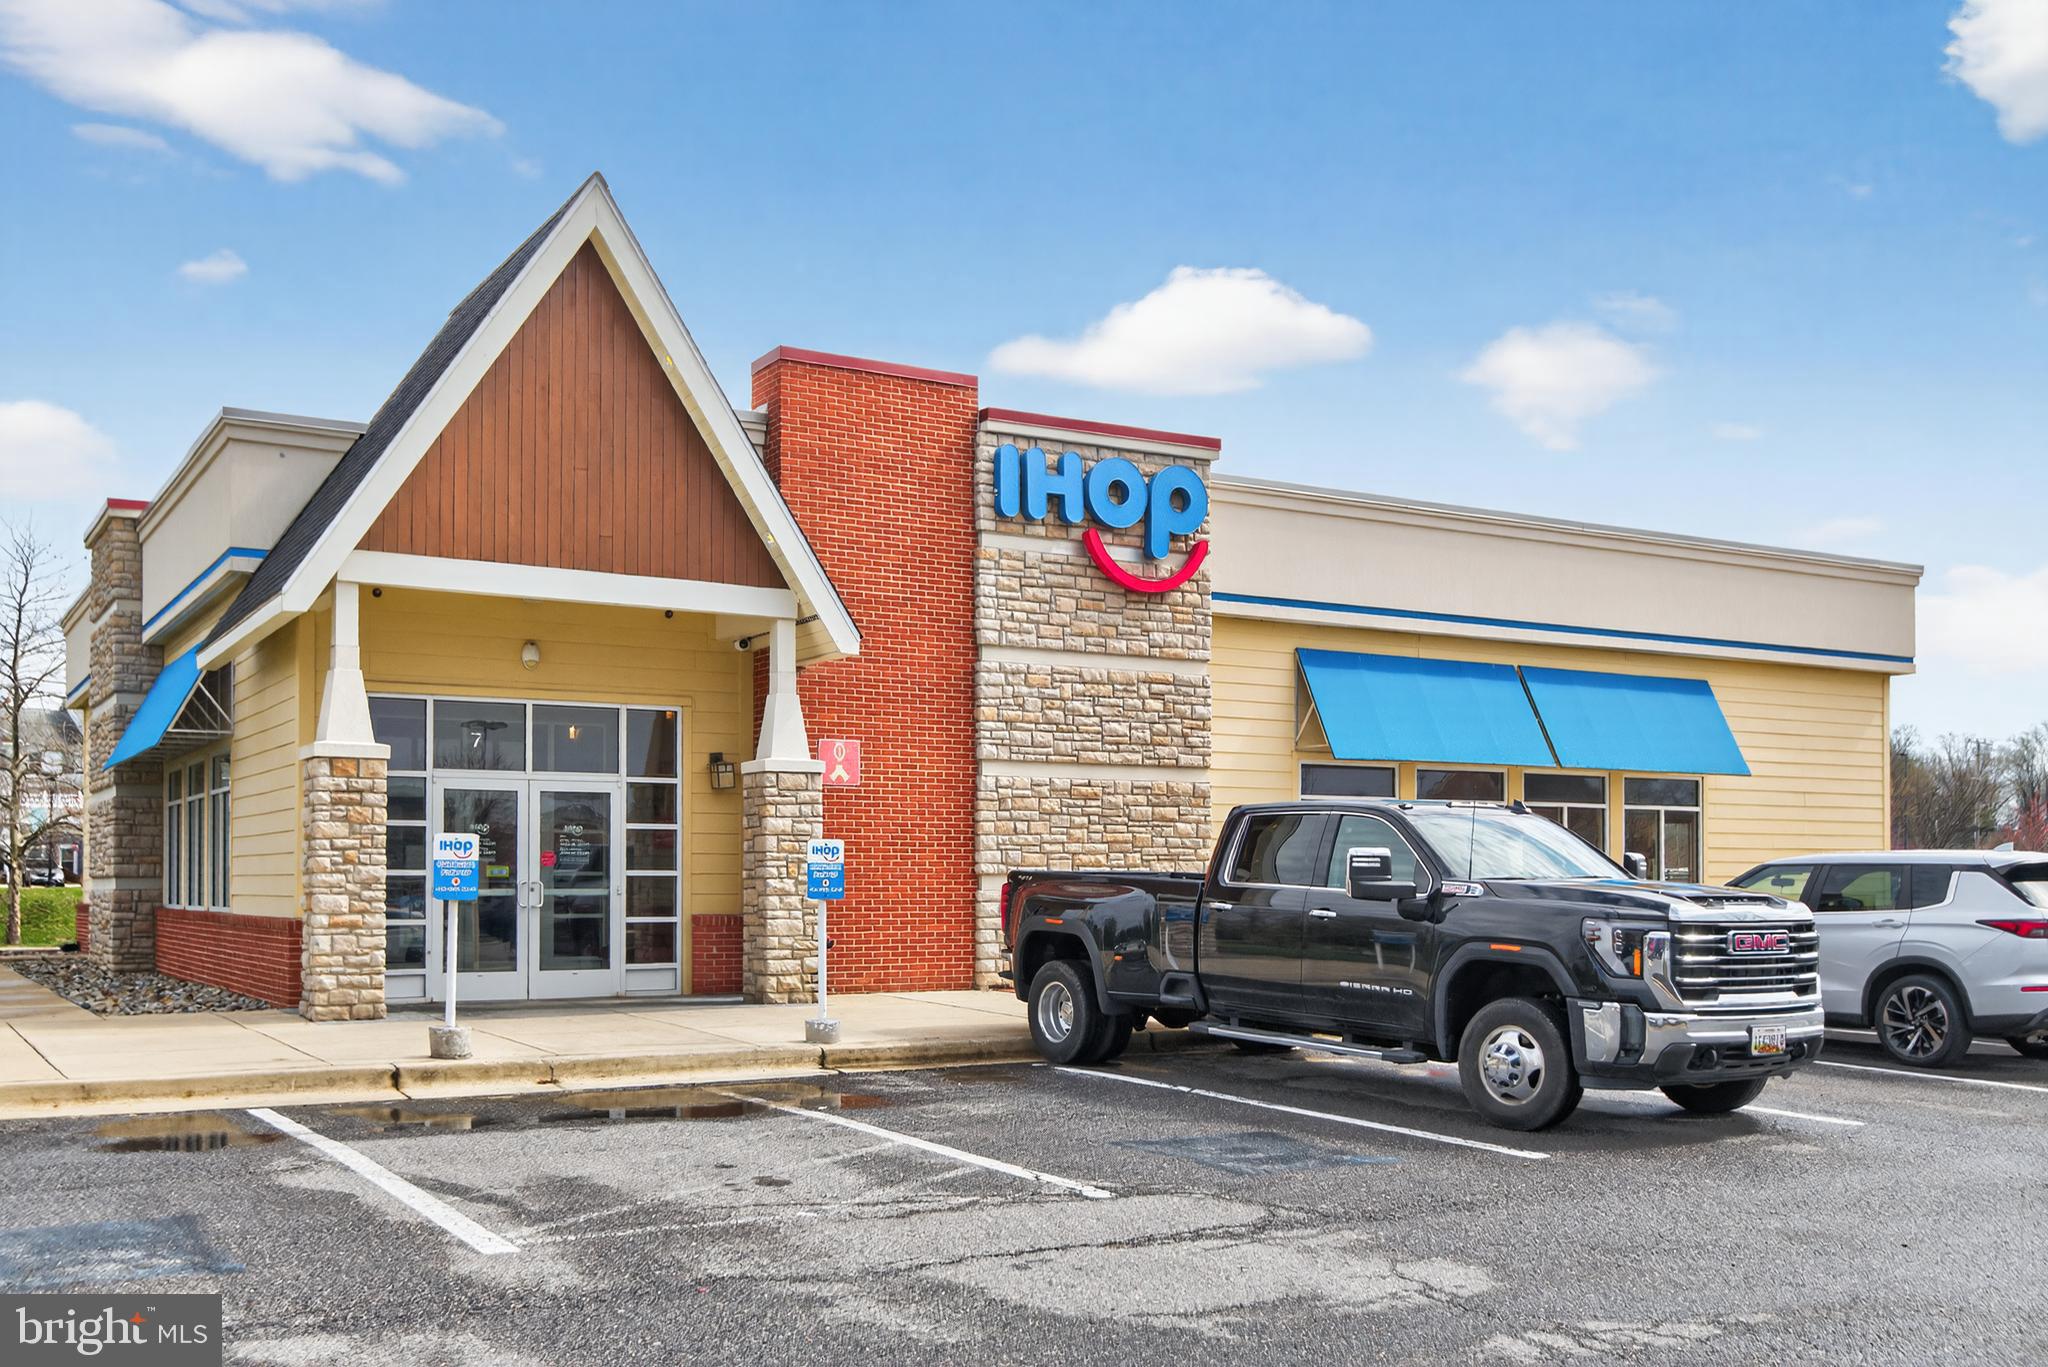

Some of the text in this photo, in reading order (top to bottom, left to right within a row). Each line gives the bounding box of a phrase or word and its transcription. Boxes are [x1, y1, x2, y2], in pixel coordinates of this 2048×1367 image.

[994, 443, 1208, 560] IHOP
[470, 732, 482, 748] 7
[439, 840, 473, 856] IHOP
[812, 845, 840, 858] IHOP
[1735, 933, 1788, 951] GMC
[1392, 987, 1413, 996] HD
